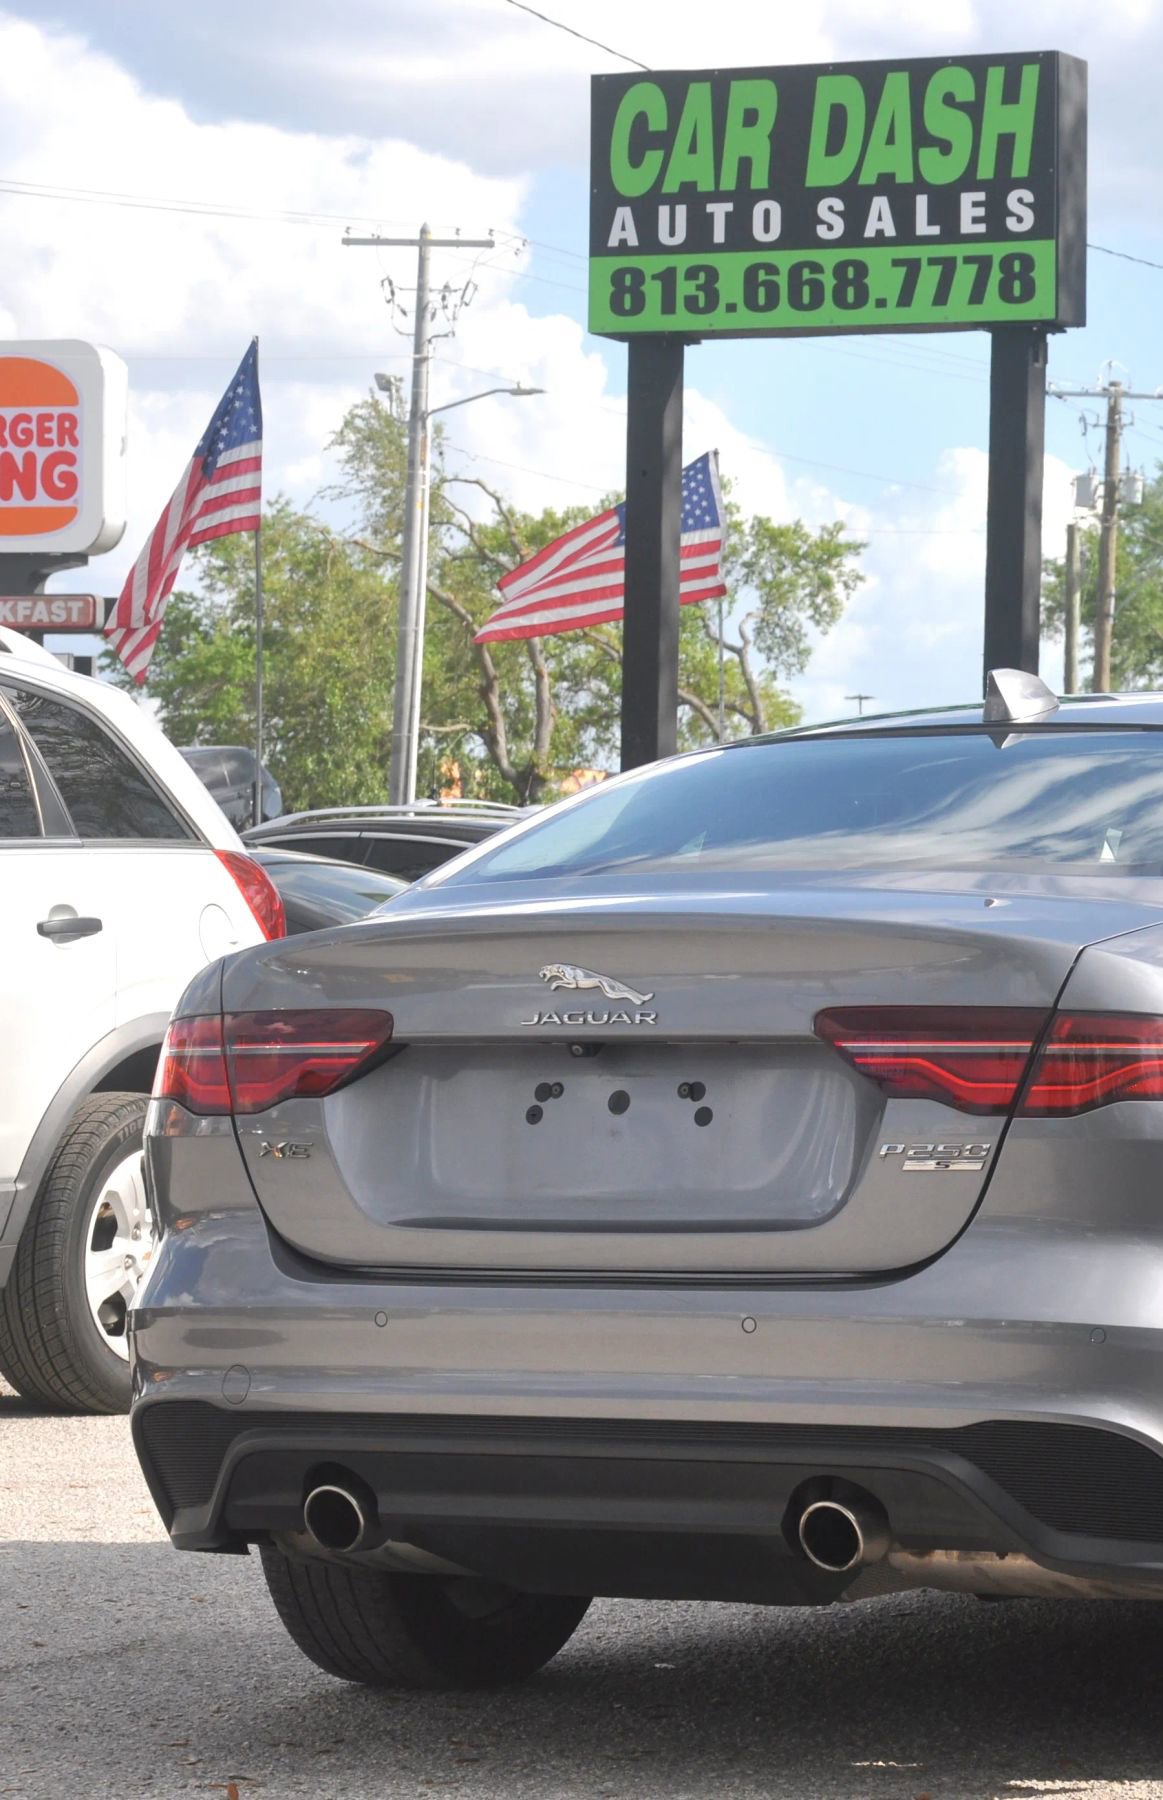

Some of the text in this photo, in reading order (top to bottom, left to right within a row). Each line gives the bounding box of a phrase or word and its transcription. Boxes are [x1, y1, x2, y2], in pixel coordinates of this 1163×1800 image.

[610, 64, 1040, 197] CAR DASH
[607, 188, 1034, 248] AUTO SALES
[609, 252, 1036, 317] 813.668.7778
[521, 1010, 657, 1025] JAGUAR
[260, 1142, 313, 1158] XE
